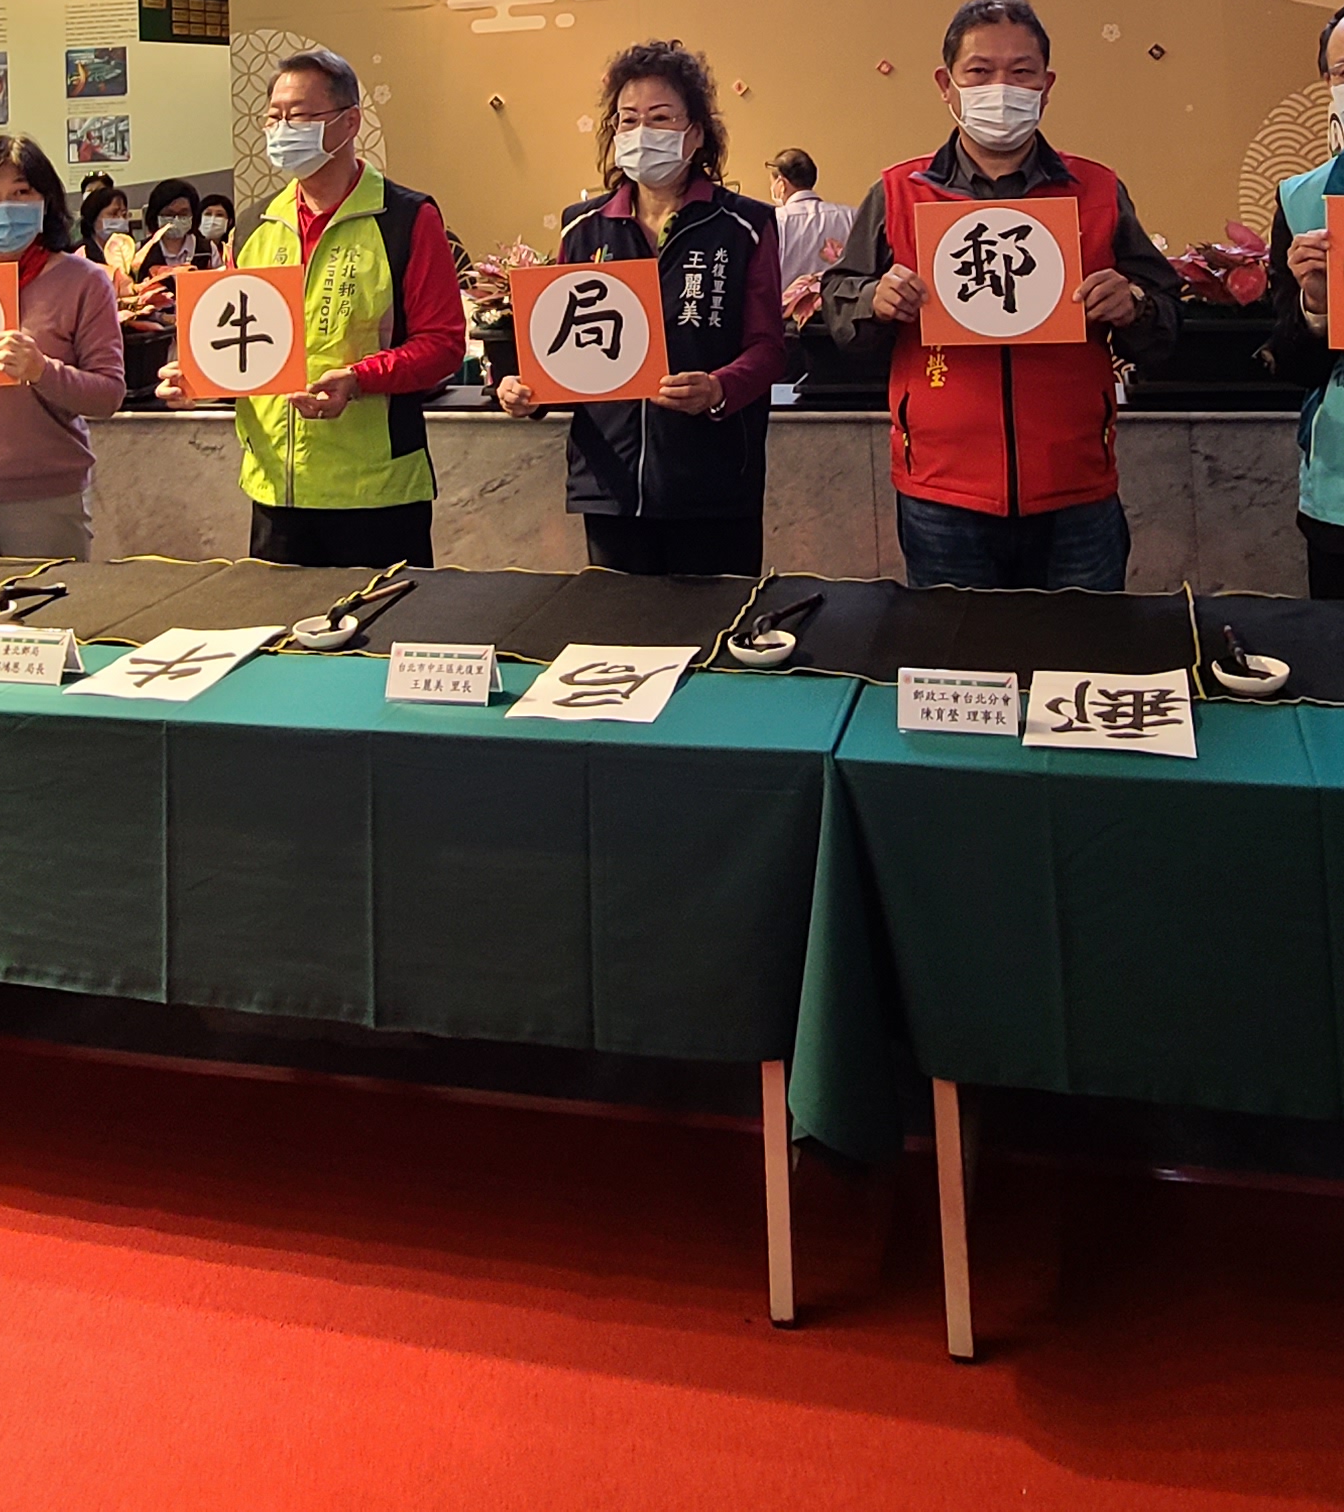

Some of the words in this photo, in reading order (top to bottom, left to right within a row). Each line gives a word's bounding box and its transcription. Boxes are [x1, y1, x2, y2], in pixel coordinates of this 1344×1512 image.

[322, 245, 341, 292] TAIPEI
[707, 247, 729, 328] 光復里里長
[950, 223, 1037, 313] 郵
[677, 250, 707, 328] 王麗美
[210, 290, 275, 373] 牛
[318, 295, 332, 335] POST
[547, 279, 623, 361] 局
[925, 345, 949, 388] 瑩
[2, 644, 40, 657] 臺北郵局
[25, 662, 45, 676] 局長
[398, 662, 485, 676] 台北市中正區光復里
[410, 678, 444, 692] 王麗美
[450, 679, 472, 694] 里長
[913, 689, 1012, 707] 郵政工會台北分會
[966, 709, 1007, 725] 理事長
